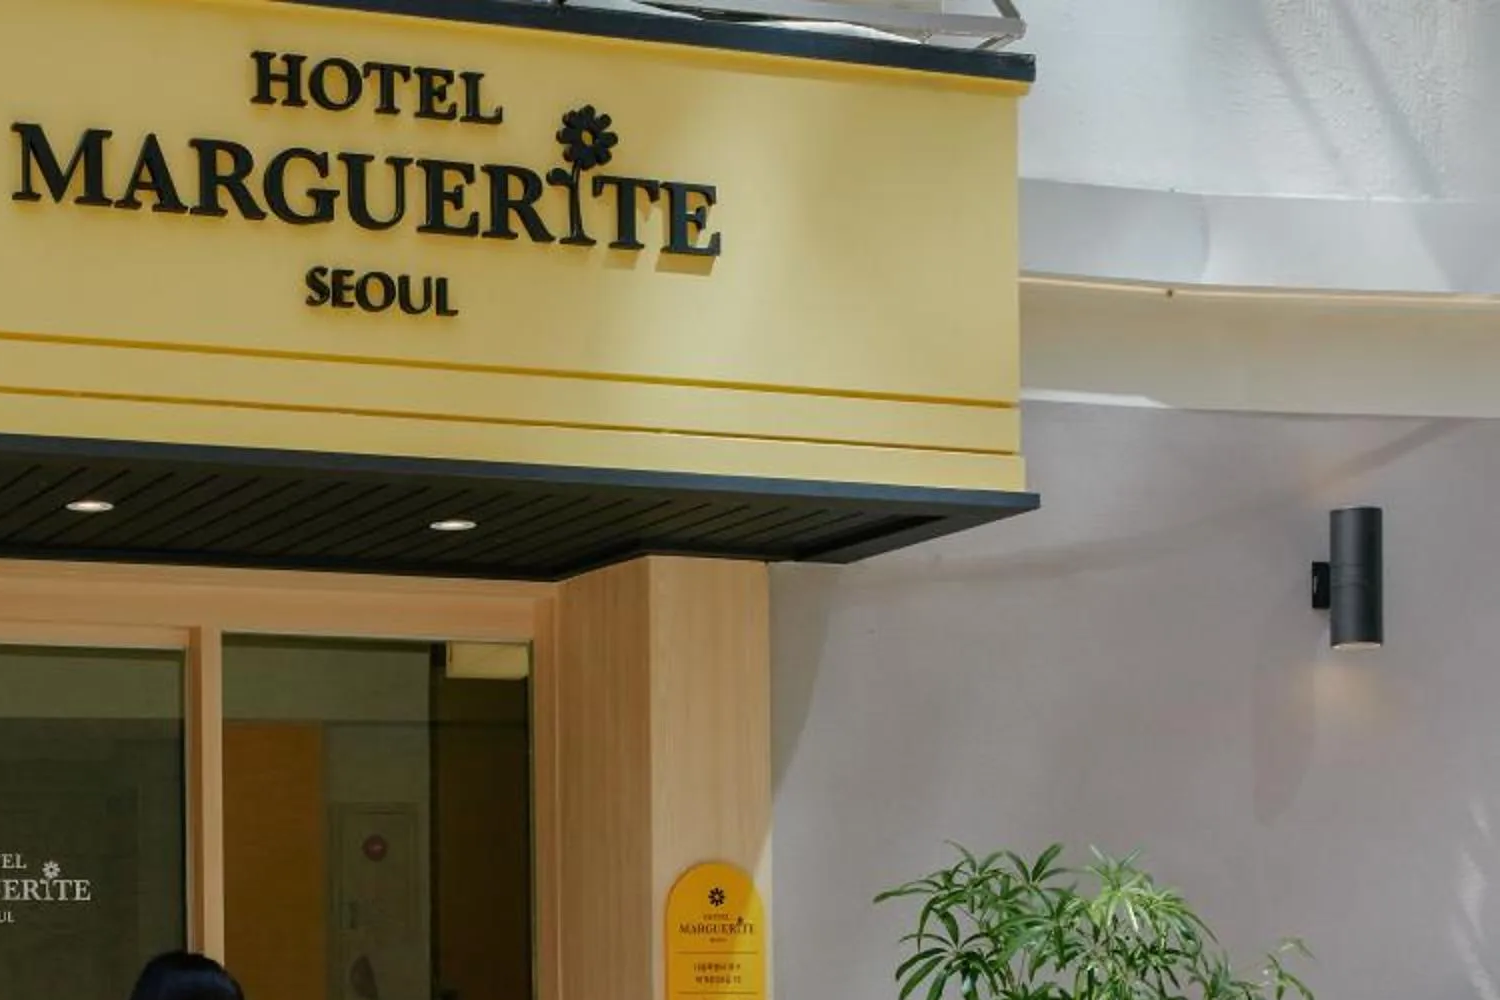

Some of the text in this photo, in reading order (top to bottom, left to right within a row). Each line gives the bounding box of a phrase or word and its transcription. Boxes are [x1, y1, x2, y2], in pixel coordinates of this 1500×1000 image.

[250, 50, 503, 125] HOTEL
[10, 104, 721, 256] MARGUERITE
[304, 265, 459, 317] SEOUL
